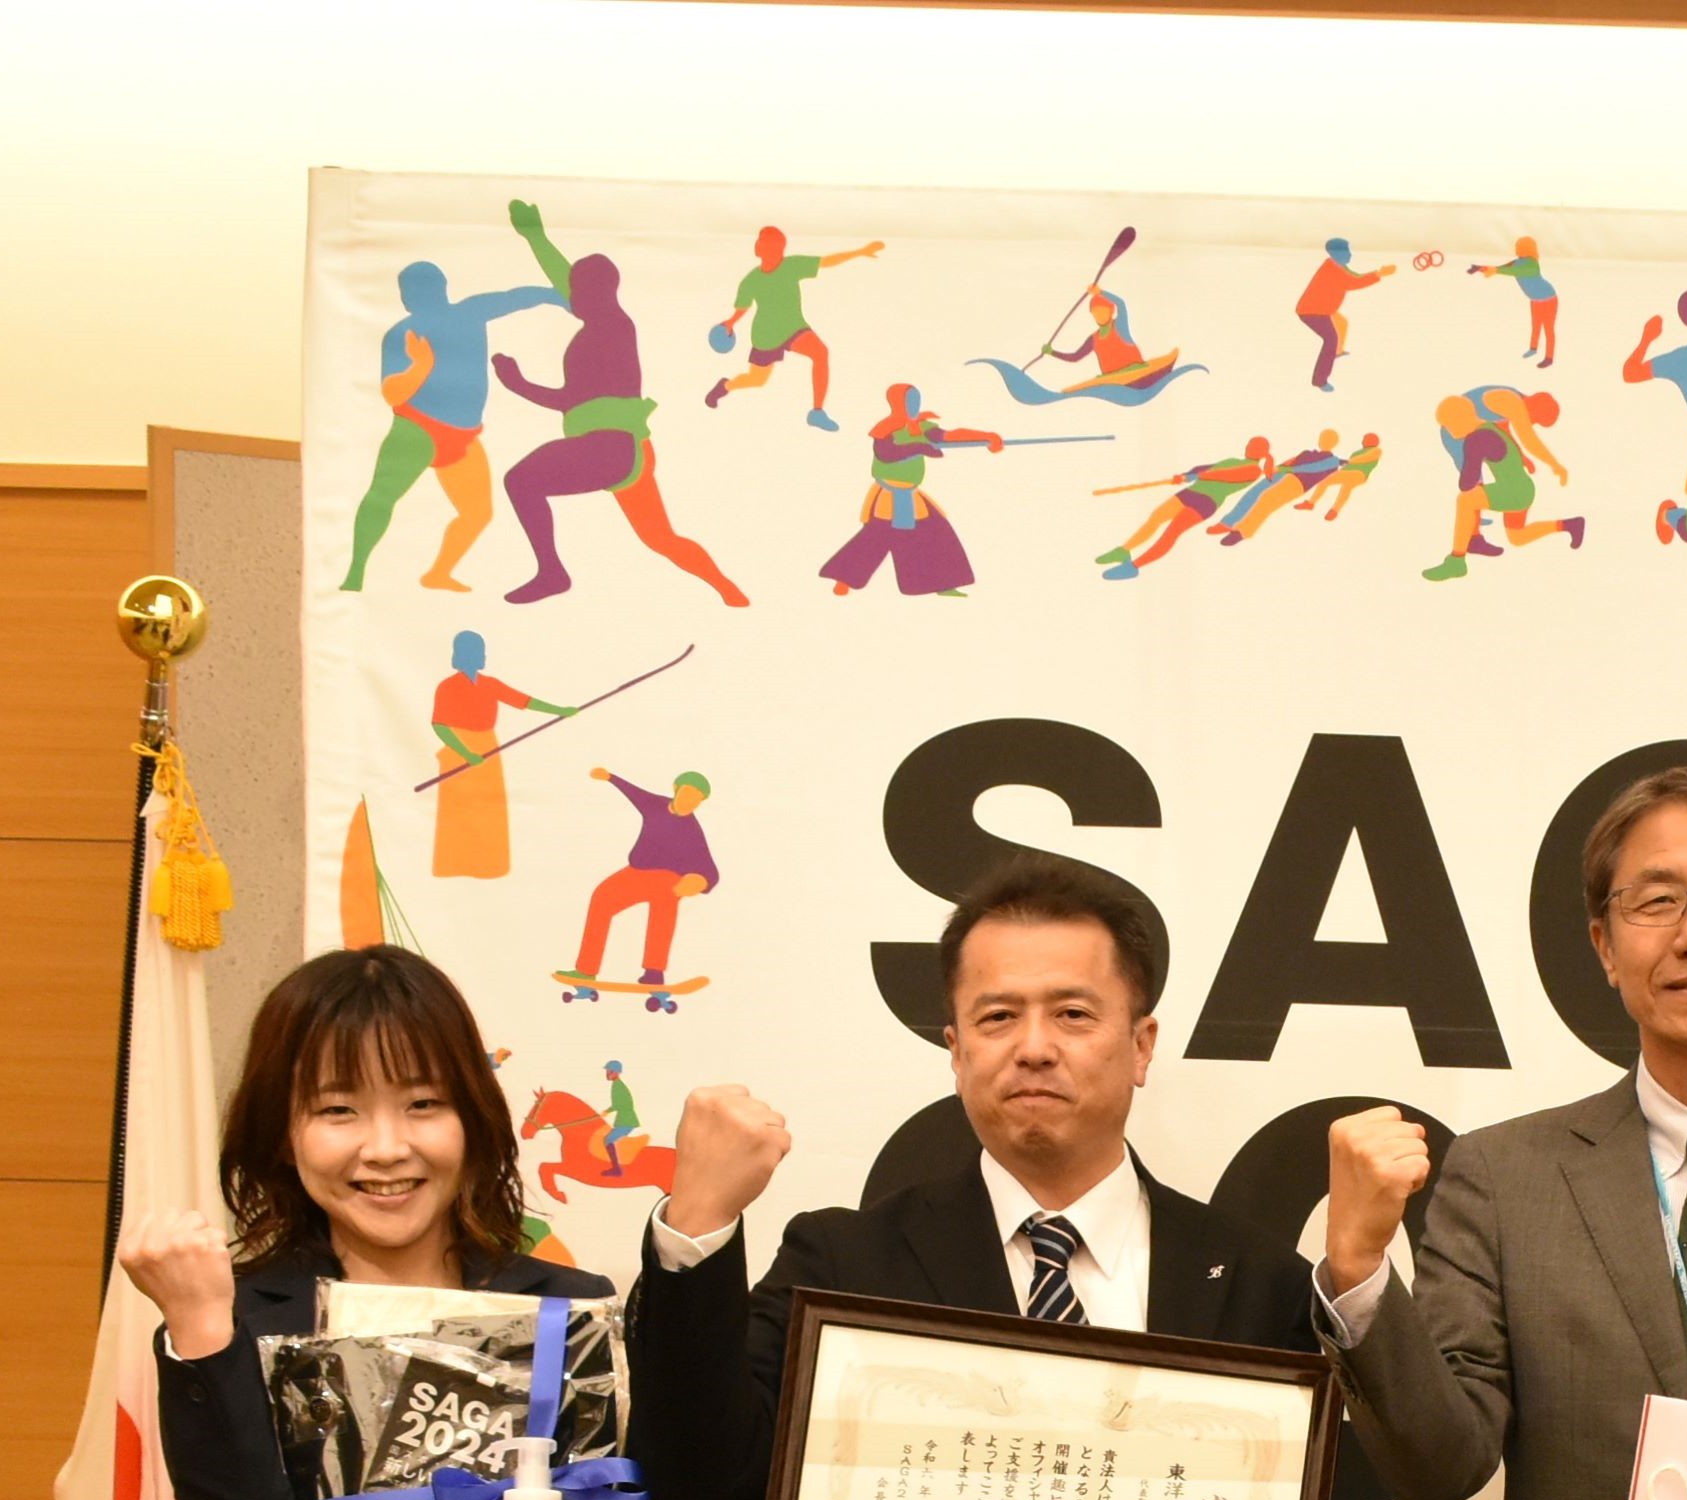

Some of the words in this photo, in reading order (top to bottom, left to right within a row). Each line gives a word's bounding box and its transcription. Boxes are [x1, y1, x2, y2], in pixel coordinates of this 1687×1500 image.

[394, 1411, 507, 1474] 2024
[409, 1382, 513, 1442] SAGA
[955, 1431, 976, 1496] 表します
